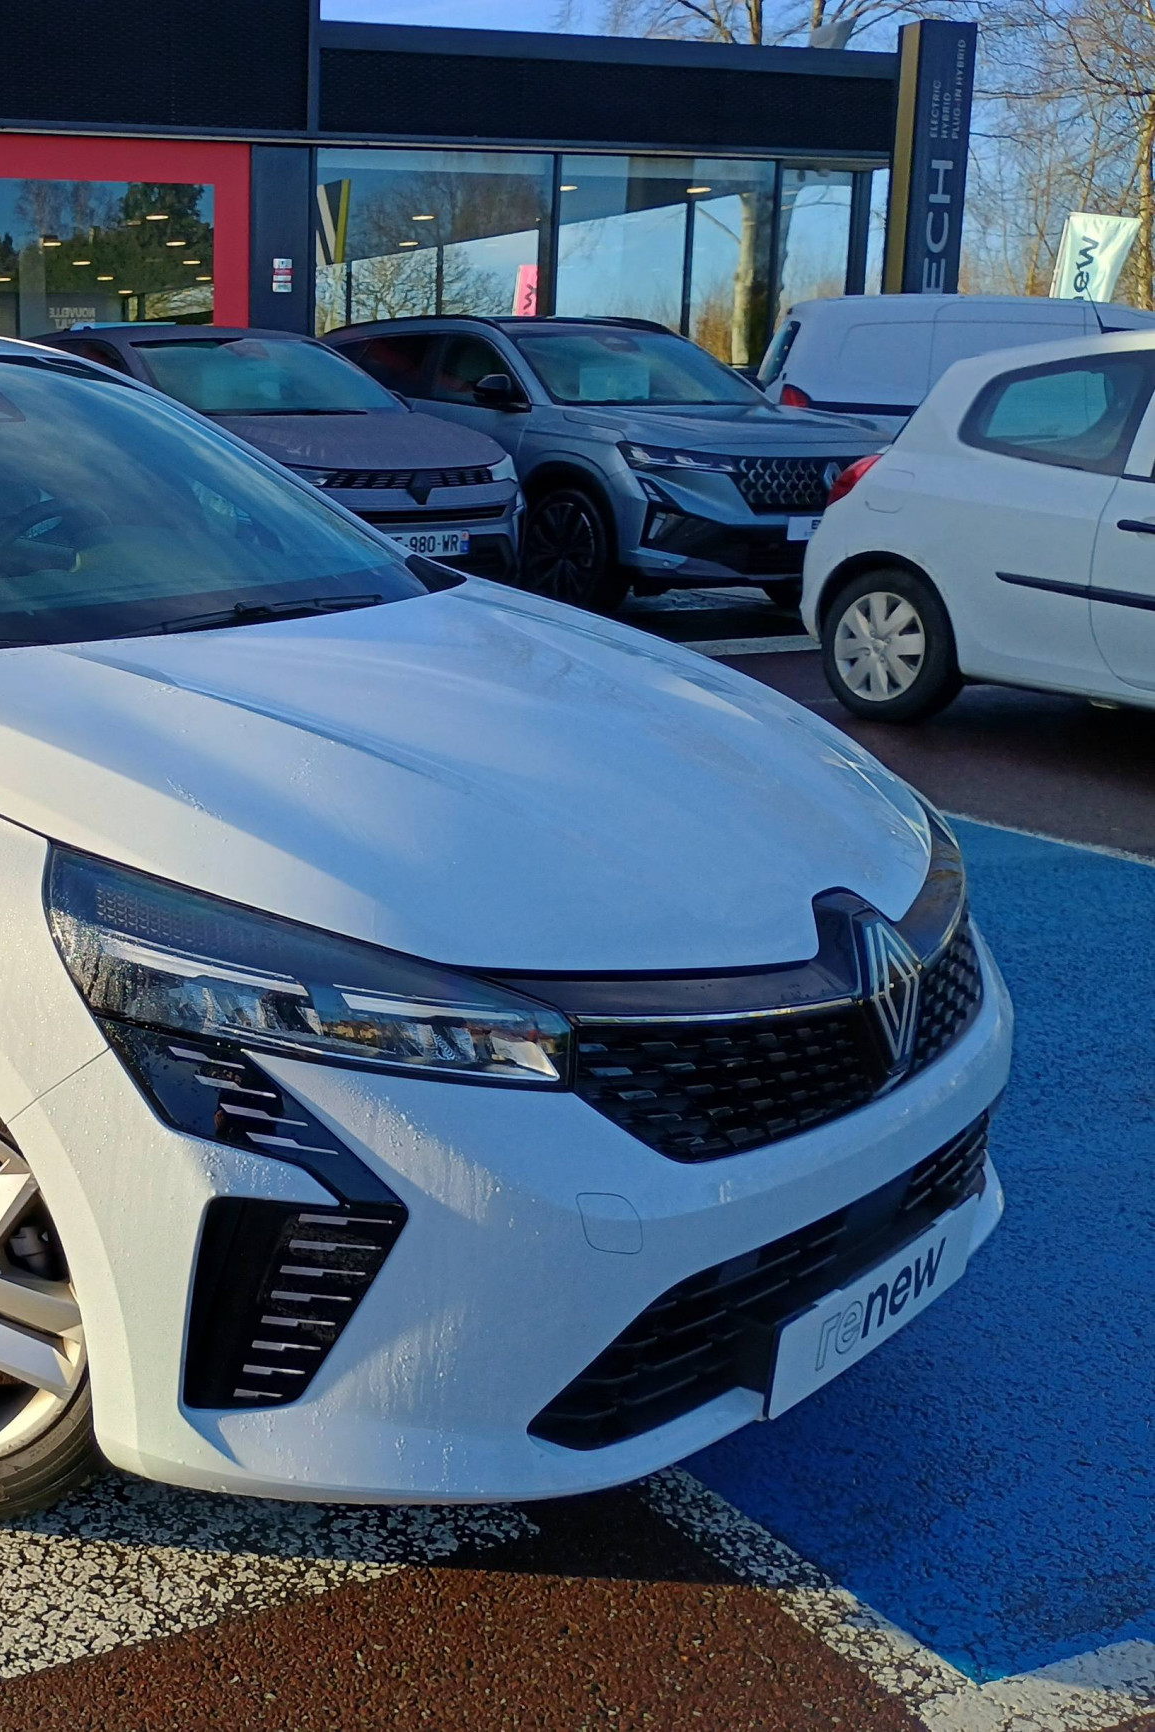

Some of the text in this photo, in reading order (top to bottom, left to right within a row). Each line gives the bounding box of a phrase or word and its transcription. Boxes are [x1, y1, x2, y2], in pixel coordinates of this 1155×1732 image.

[956, 39, 966, 85] HYBRID
[929, 80, 942, 138] ELECTRIC
[941, 92, 951, 139] HYBRID
[1072, 235, 1100, 300] ew
[814, 1236, 946, 1372] renew
